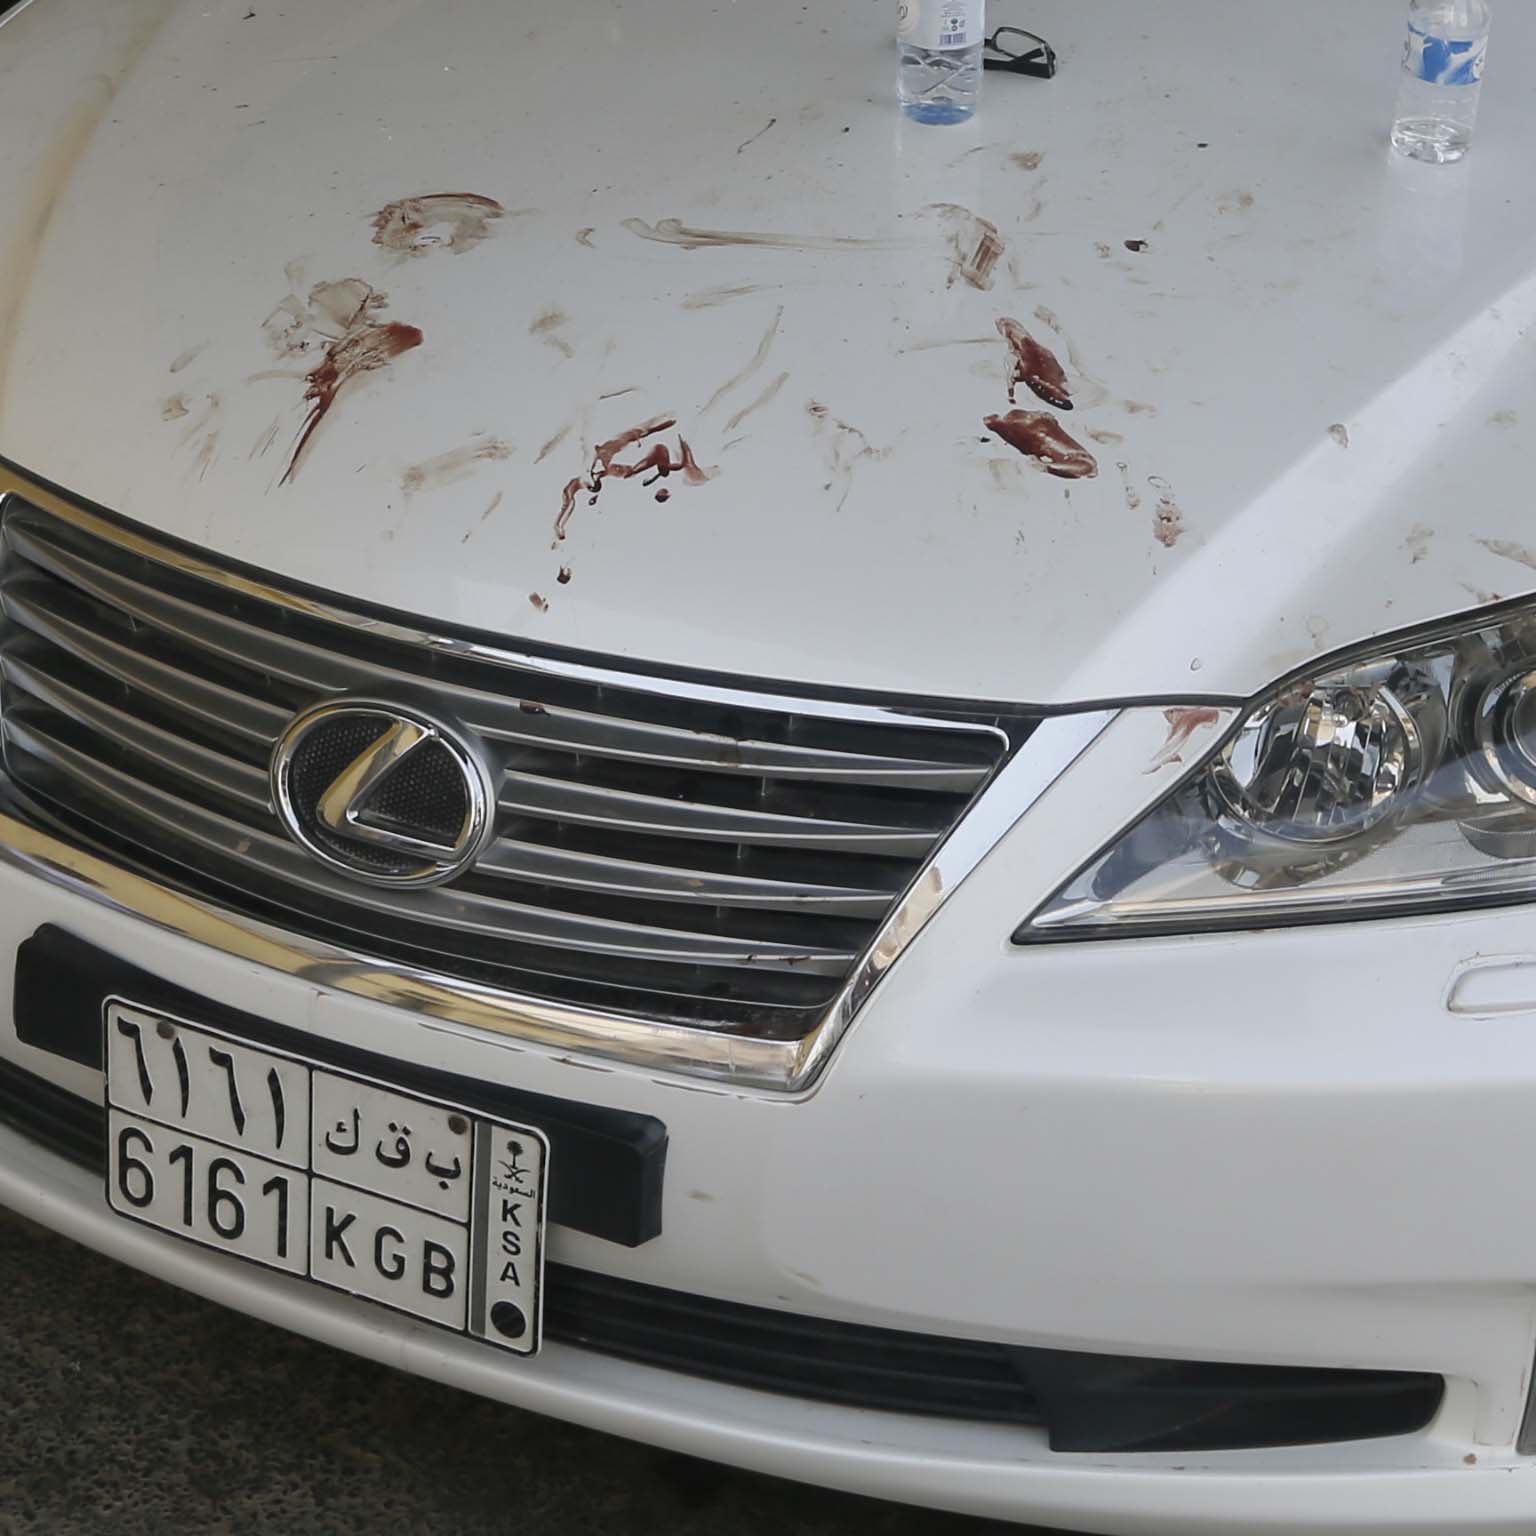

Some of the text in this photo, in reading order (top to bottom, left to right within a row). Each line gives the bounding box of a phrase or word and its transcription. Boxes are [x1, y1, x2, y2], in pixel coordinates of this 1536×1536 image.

[117, 1016, 287, 1149] ٦١٦١
[117, 1126, 455, 1300] 6161 KGB
[491, 1175, 537, 1200] السعودية
[499, 1198, 523, 1288] KSA
